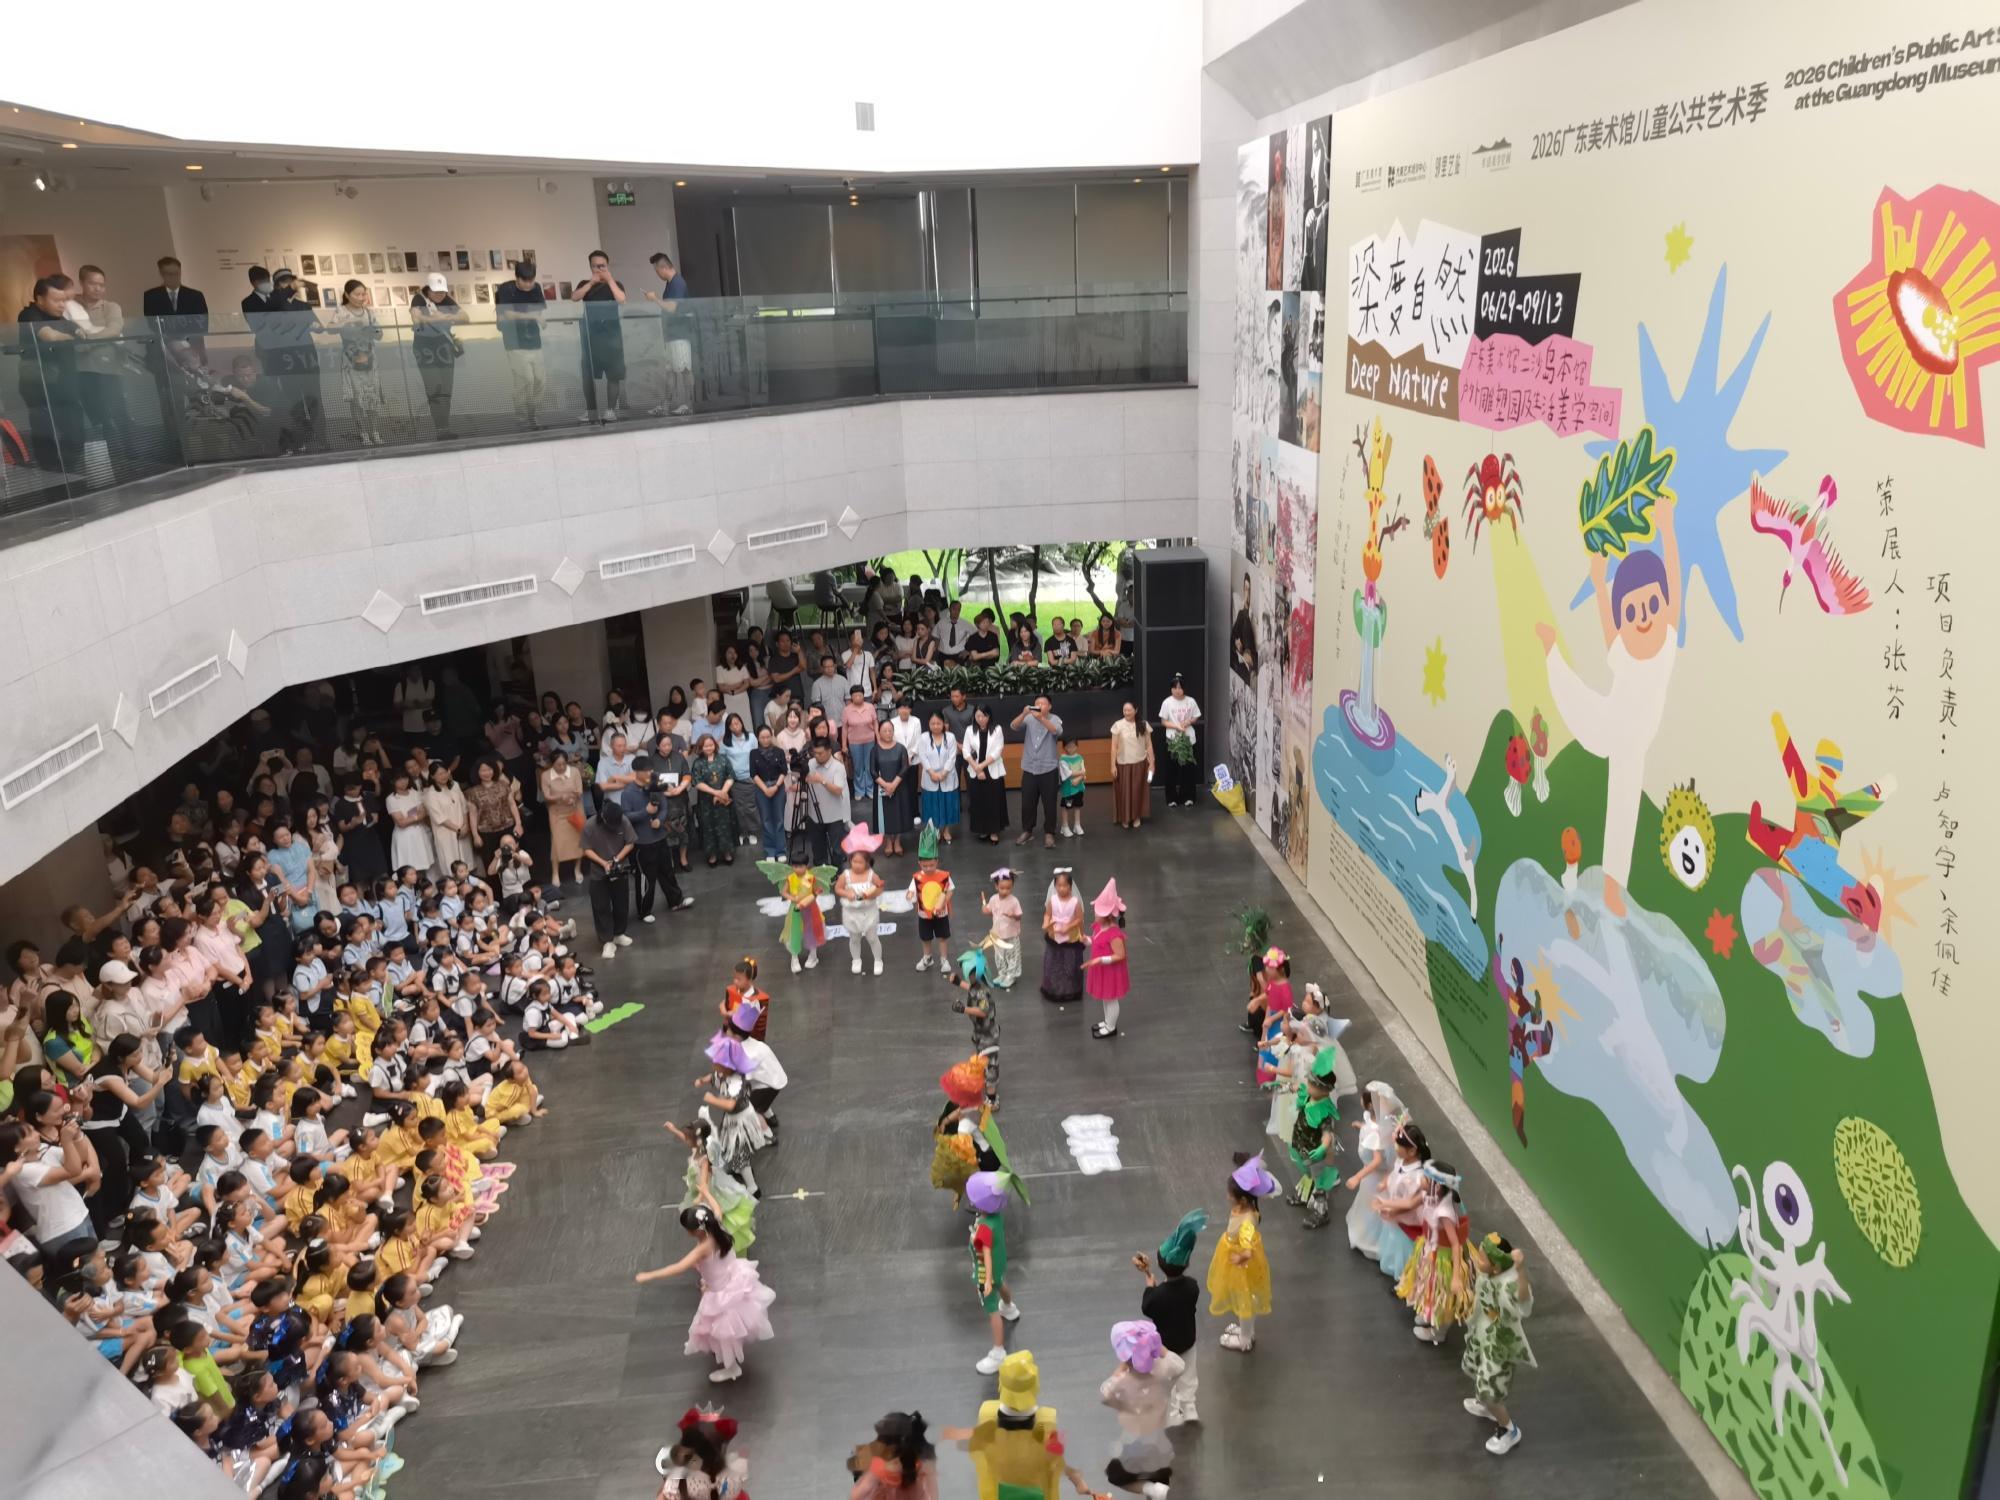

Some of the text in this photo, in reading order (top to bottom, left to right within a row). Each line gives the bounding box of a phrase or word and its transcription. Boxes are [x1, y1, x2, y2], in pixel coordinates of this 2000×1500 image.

[1784, 64, 1826, 90] 2026
[1827, 45, 1905, 81] Children's
[1905, 32, 1959, 63] Public
[1960, 26, 1995, 51] Art
[1794, 92, 1810, 110] at
[1811, 87, 1835, 107] the
[1835, 71, 1928, 101] Guangdong
[1531, 81, 1769, 160] 2026广东美术馆儿童公共艺术季
[1484, 247, 1515, 278] 2026
[1351, 237, 1474, 354] 深度自然
[1480, 289, 1563, 325] 06/29-09/13
[1351, 354, 1449, 409] Deep Nature
